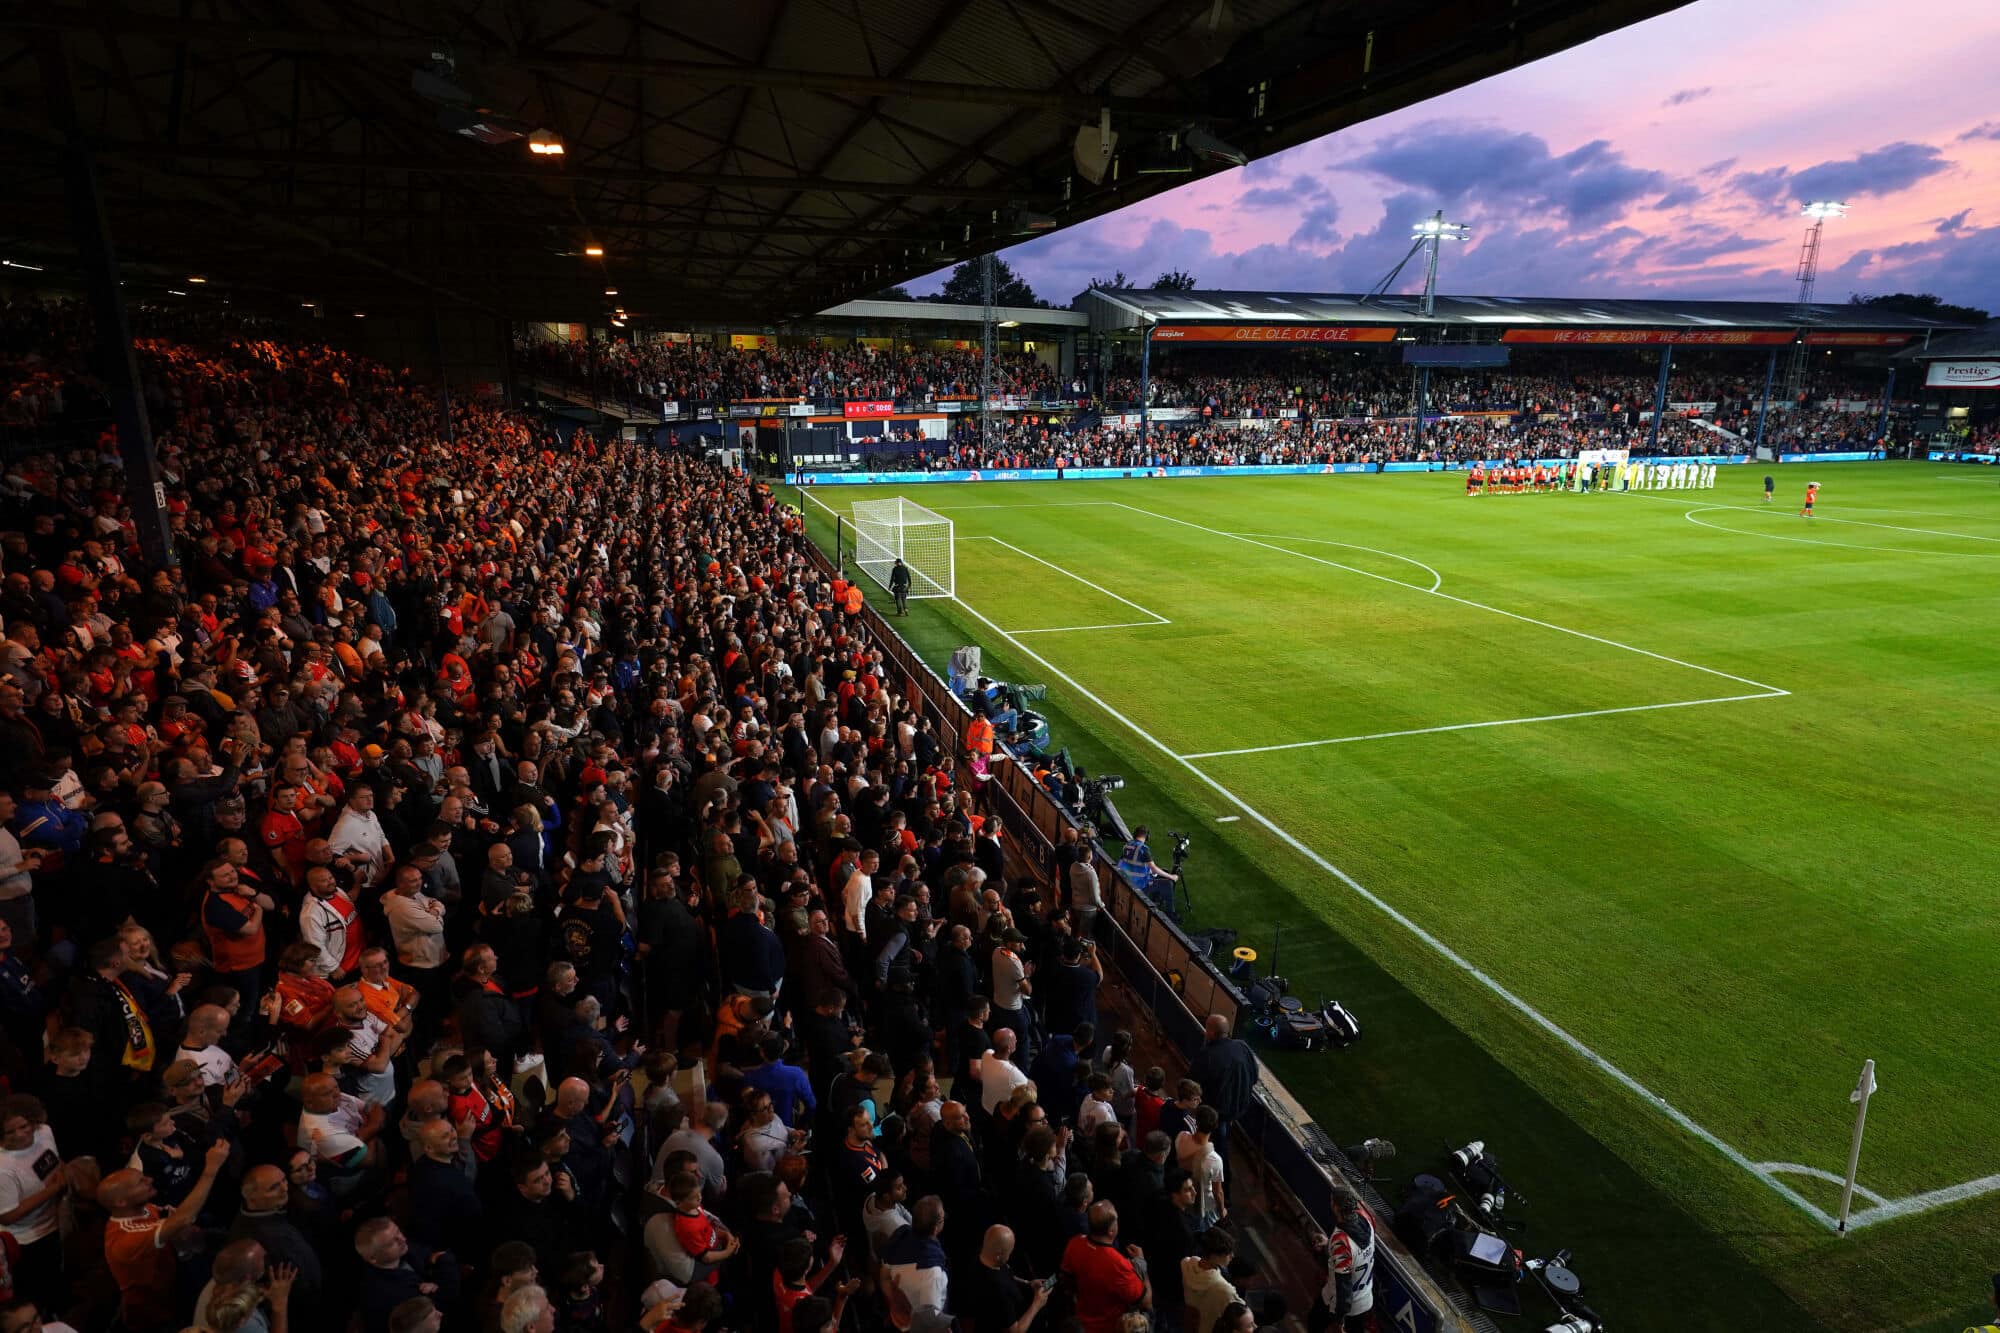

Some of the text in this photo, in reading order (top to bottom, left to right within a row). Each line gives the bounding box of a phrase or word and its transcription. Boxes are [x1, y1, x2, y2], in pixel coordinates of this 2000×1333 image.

[1553, 331, 1573, 342] WE
[1574, 331, 1595, 342] ARE
[1597, 332, 1617, 342] THE
[1947, 366, 1991, 376] Prestige
